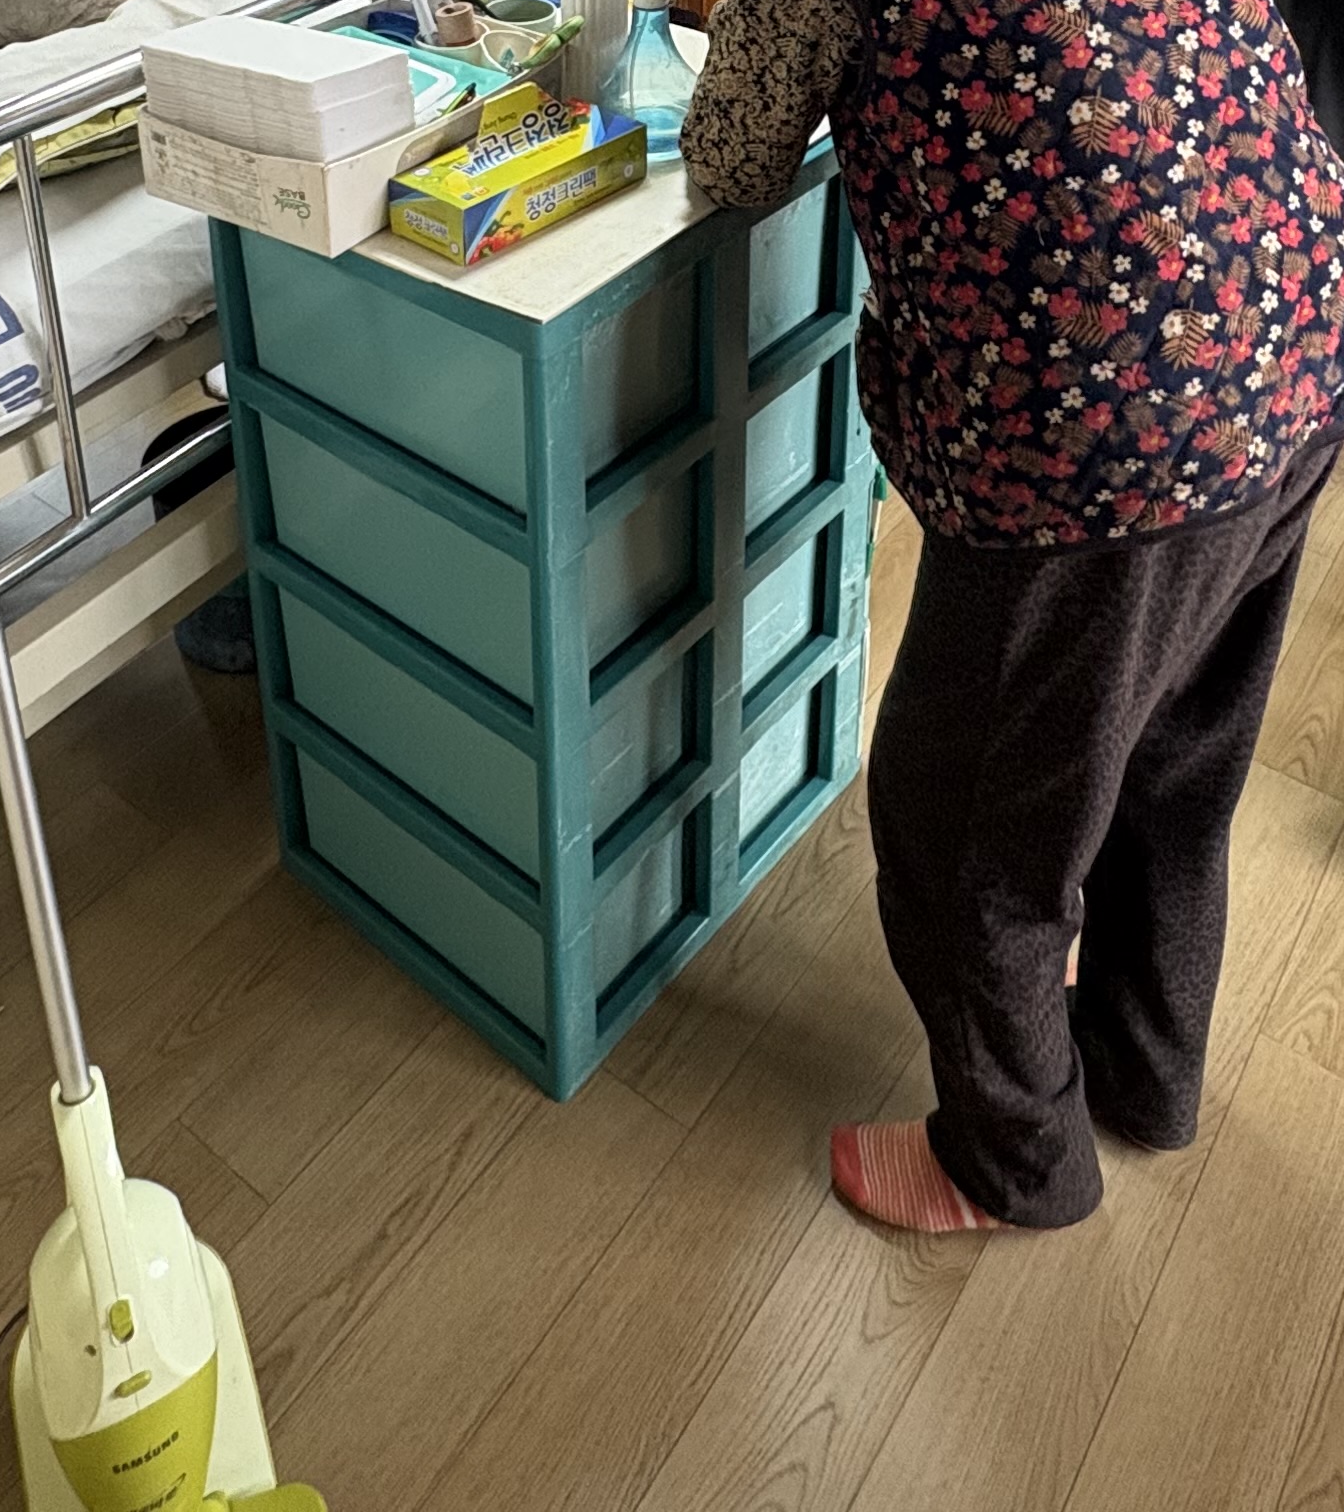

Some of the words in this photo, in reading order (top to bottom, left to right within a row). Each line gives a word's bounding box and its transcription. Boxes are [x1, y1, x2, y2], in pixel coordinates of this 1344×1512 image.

[277, 187, 306, 201] BASE
[524, 167, 597, 221] 청정크린팩
[112, 1431, 179, 1475] SAMSUNG
